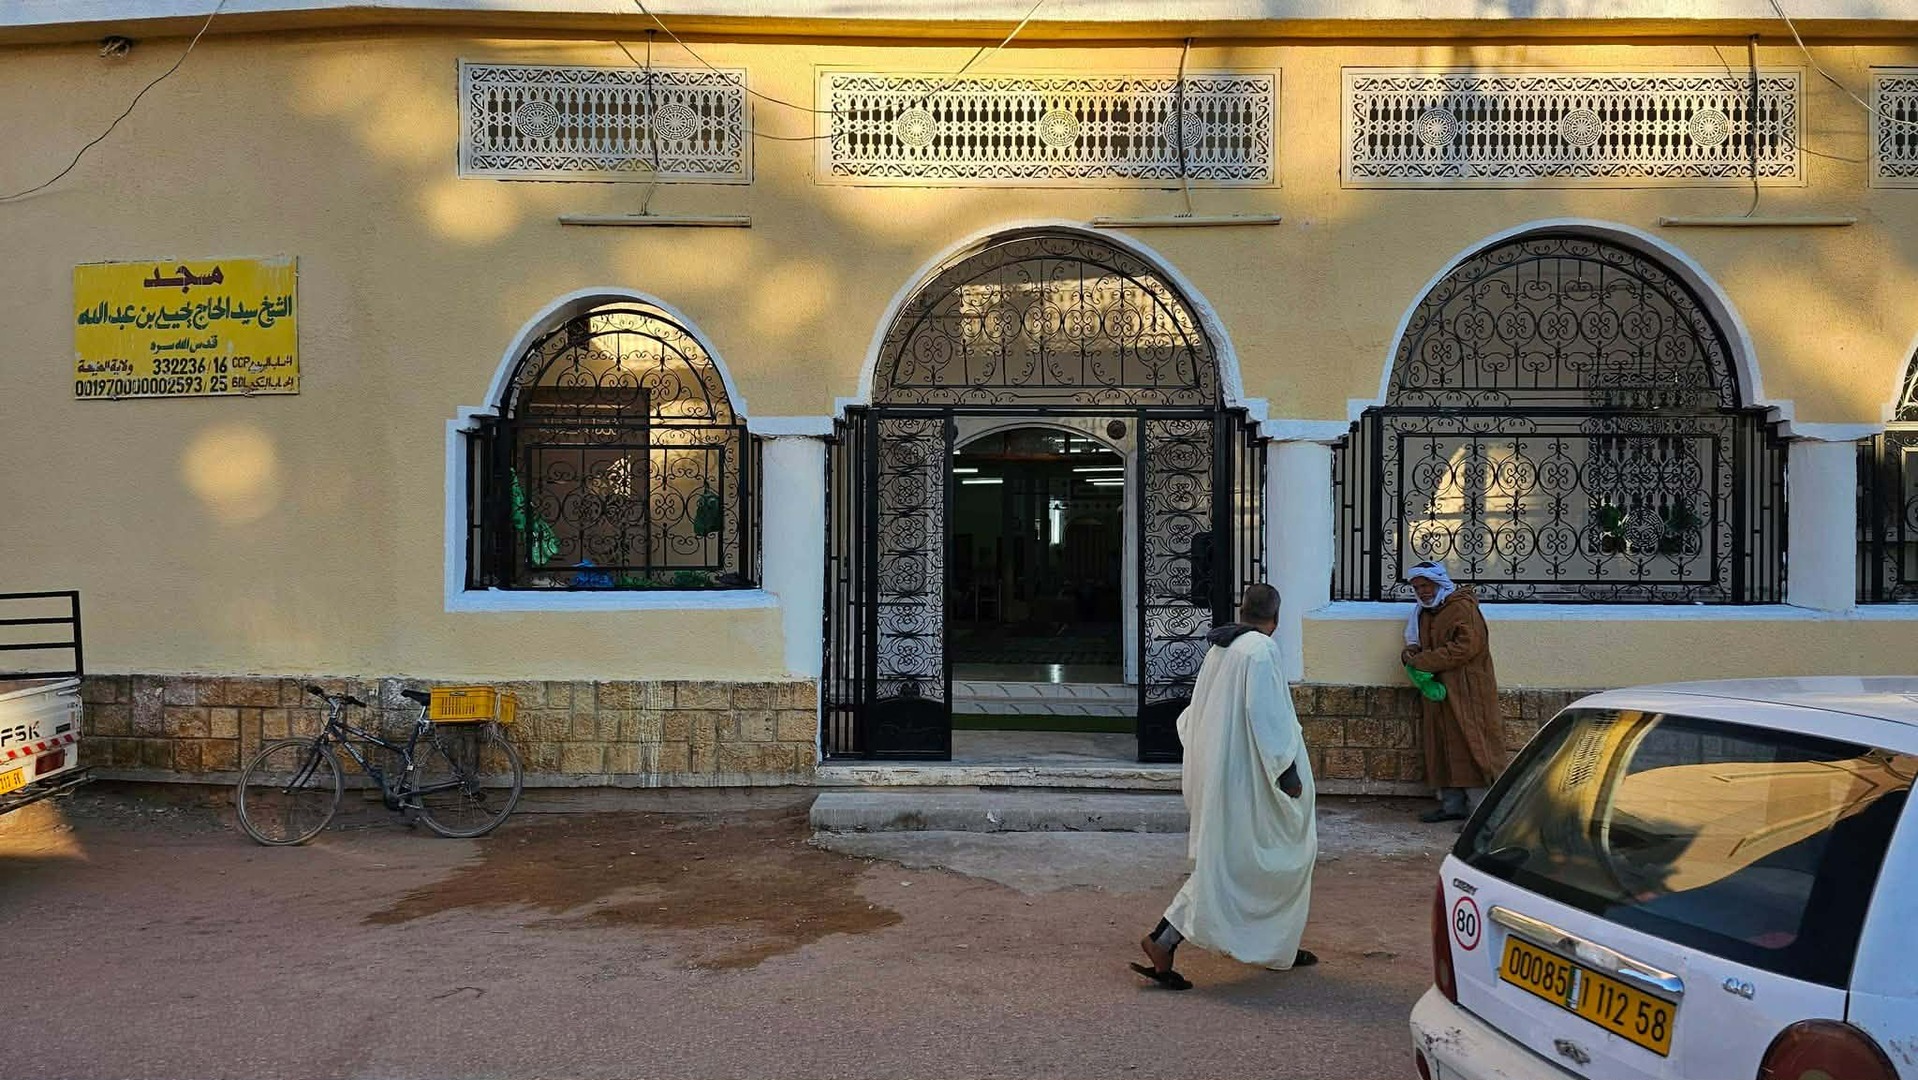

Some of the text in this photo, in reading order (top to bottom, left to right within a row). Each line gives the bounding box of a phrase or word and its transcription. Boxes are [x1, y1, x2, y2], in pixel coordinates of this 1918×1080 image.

[143, 265, 224, 294] مسجد
[135, 306, 157, 330] بن
[193, 295, 231, 330] الحاج
[258, 294, 293, 329] الشيخ
[150, 341, 175, 355] سره
[189, 335, 218, 354] قدس
[110, 359, 134, 376] ولاية
[232, 356, 250, 368] CCP
[1457, 909, 1476, 937] 80
[1509, 947, 1569, 997] 00085
[1635, 1001, 1667, 1042] 58
